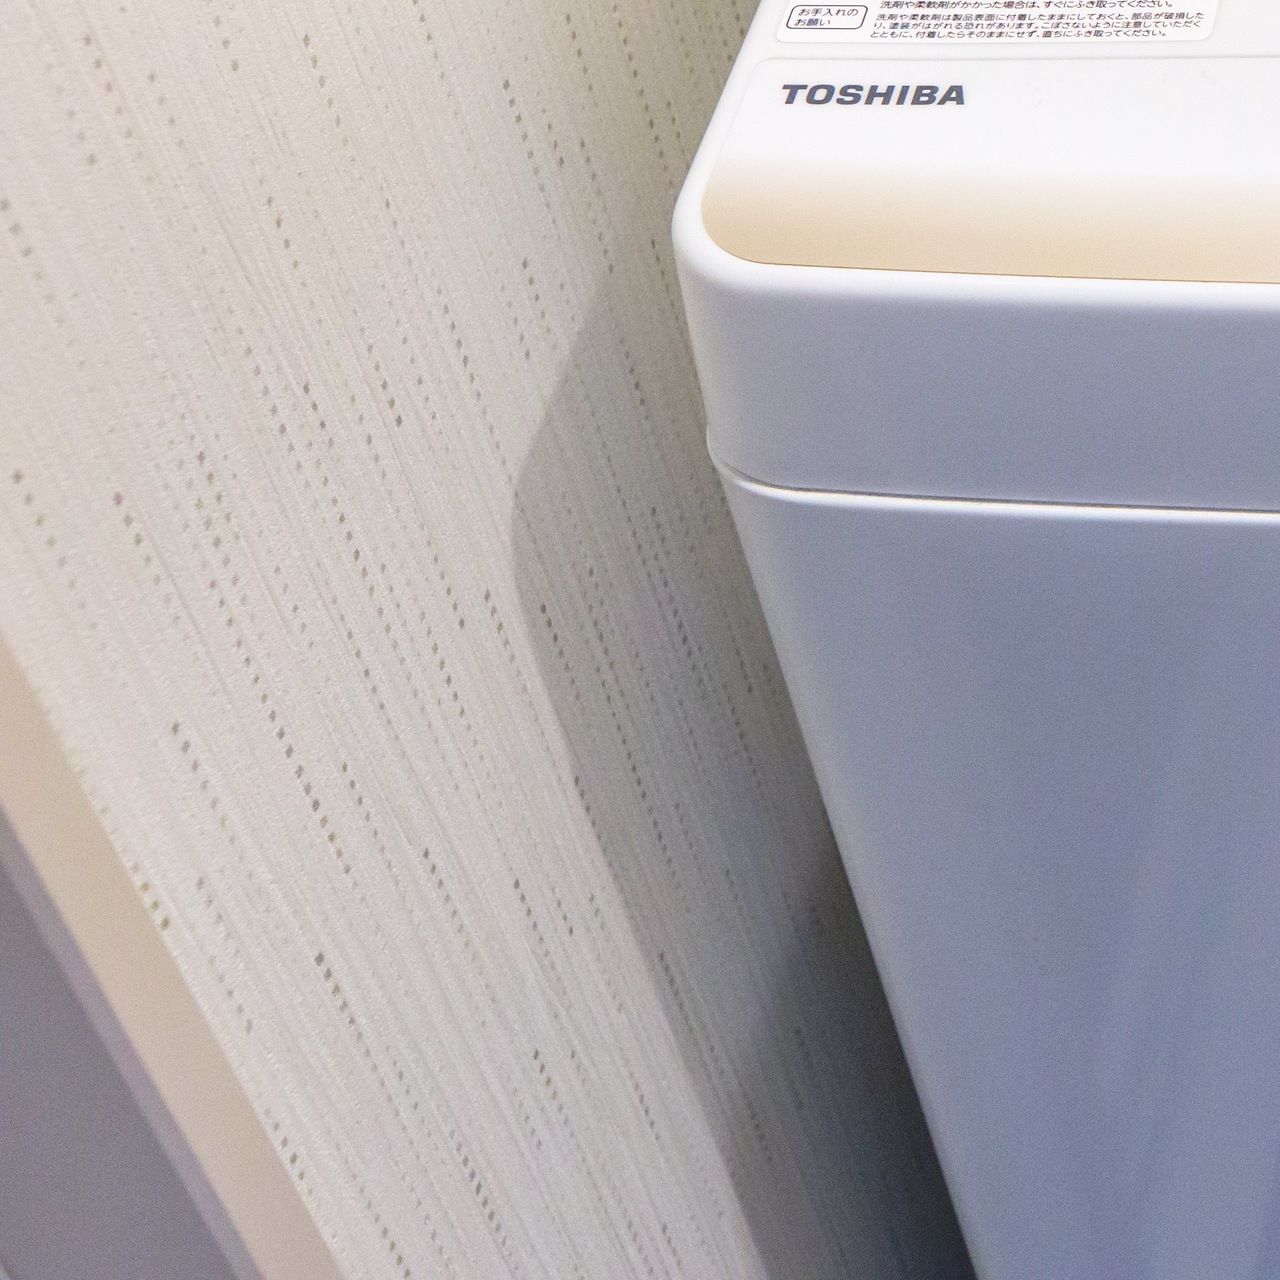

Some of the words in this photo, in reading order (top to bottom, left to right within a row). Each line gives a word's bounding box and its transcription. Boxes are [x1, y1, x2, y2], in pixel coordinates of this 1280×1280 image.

[798, 8, 859, 17] お手入れの
[794, 17, 831, 27] お願い
[781, 84, 965, 105] TOSHIBA
